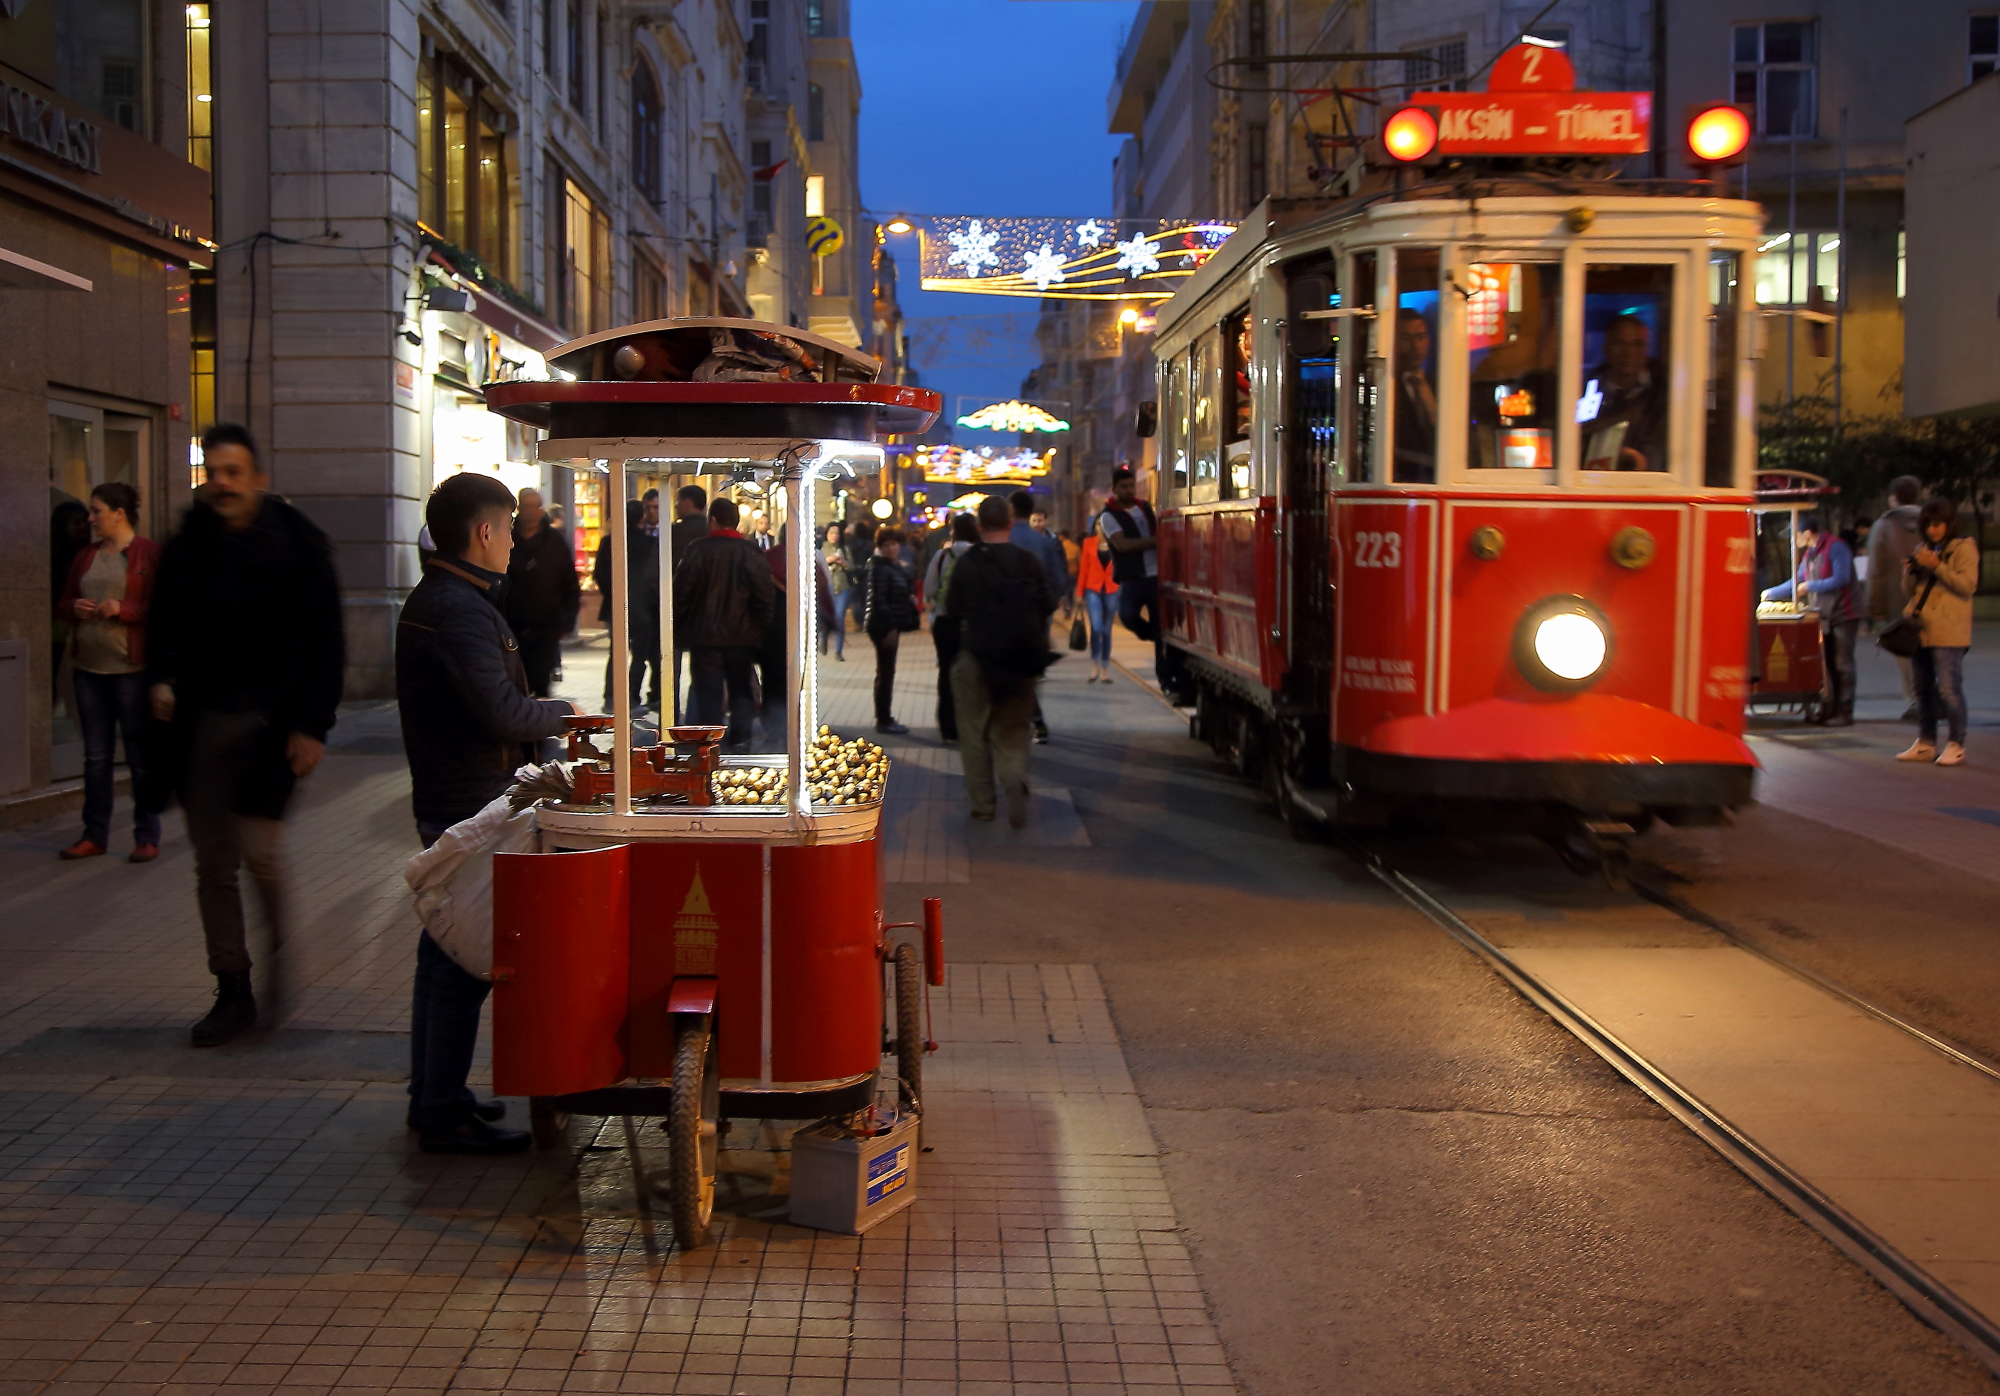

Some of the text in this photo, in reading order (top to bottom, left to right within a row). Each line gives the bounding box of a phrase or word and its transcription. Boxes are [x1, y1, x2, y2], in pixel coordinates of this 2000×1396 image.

[1521, 47, 1543, 84] 2
[1438, 103, 1515, 141] AKSİM
[1555, 103, 1642, 141] TÜNEL
[1355, 531, 1401, 568] 223
